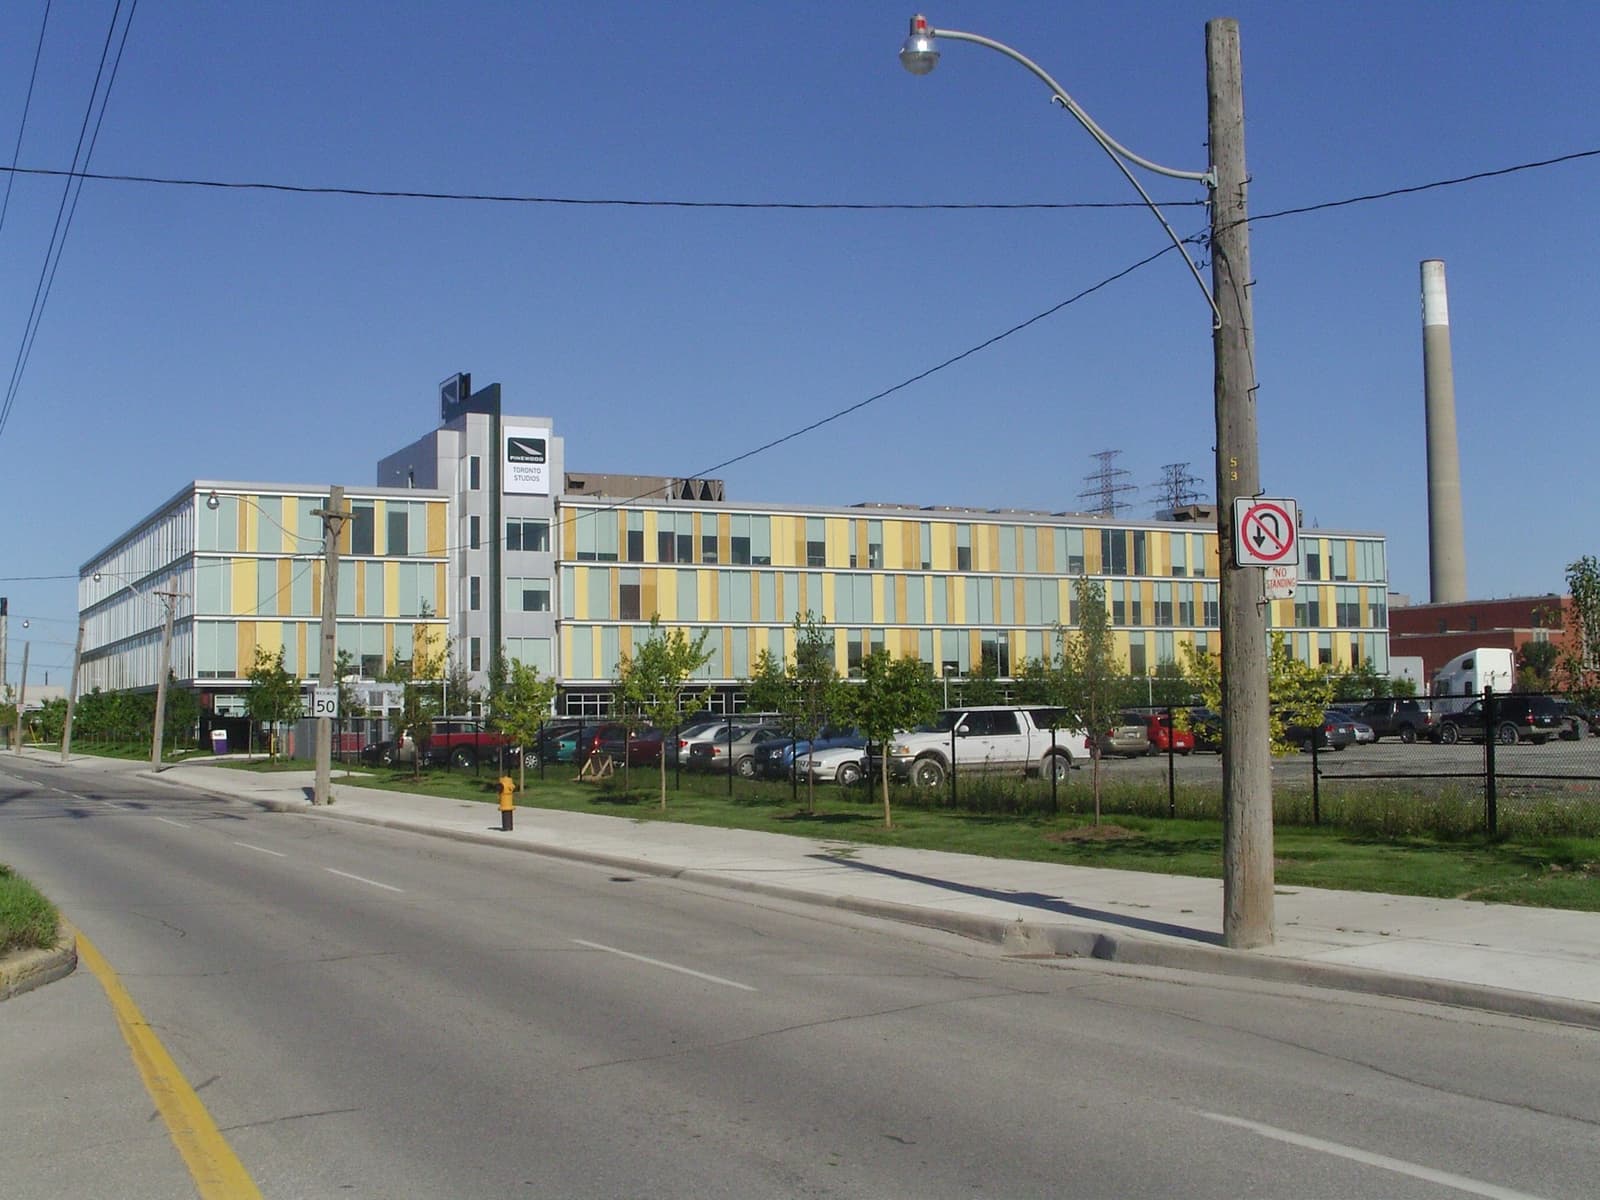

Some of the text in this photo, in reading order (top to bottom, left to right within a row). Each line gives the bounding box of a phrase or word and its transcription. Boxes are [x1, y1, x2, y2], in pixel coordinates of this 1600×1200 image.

[512, 466, 542, 474] TORONTO
[513, 474, 541, 482] STUDIOS
[1274, 567, 1287, 577] NO
[1266, 577, 1296, 589] STANDING
[316, 700, 335, 713] 50
